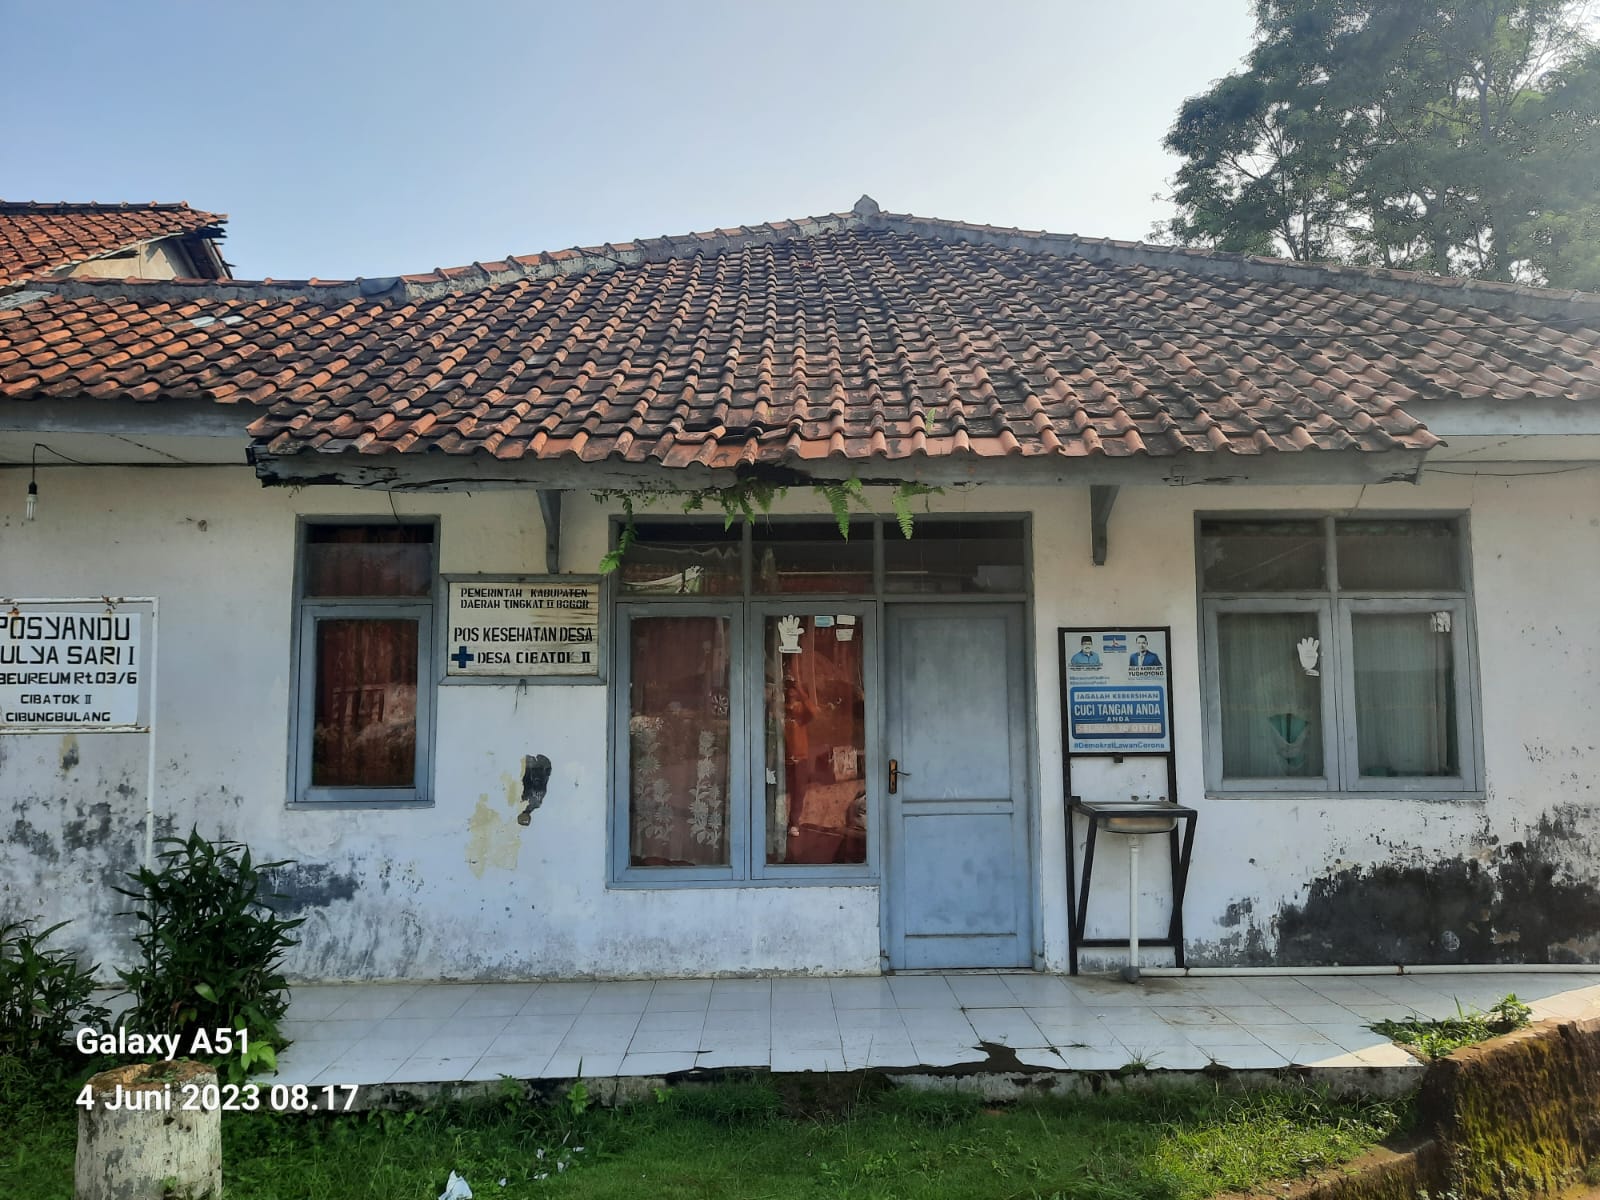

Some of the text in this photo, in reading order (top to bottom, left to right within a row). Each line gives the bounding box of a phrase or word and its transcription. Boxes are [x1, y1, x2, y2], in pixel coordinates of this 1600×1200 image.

[460, 587, 588, 598] PEMERINTAH KABUPATEN
[460, 599, 500, 609] DAERAH
[503, 599, 543, 609] TINGKAT
[556, 599, 589, 609] BOGOR
[0, 616, 130, 641] POSYANDU
[454, 627, 593, 642] POS KESEHATAN DESA
[67, 646, 121, 665] SARI
[128, 646, 135, 665] I
[477, 652, 511, 664] DESA
[20, 694, 92, 705] CIBATOK II
[1074, 703, 1161, 716] CUCI TANGAN ANDA
[5, 711, 111, 722] CIBUNGBULANG
